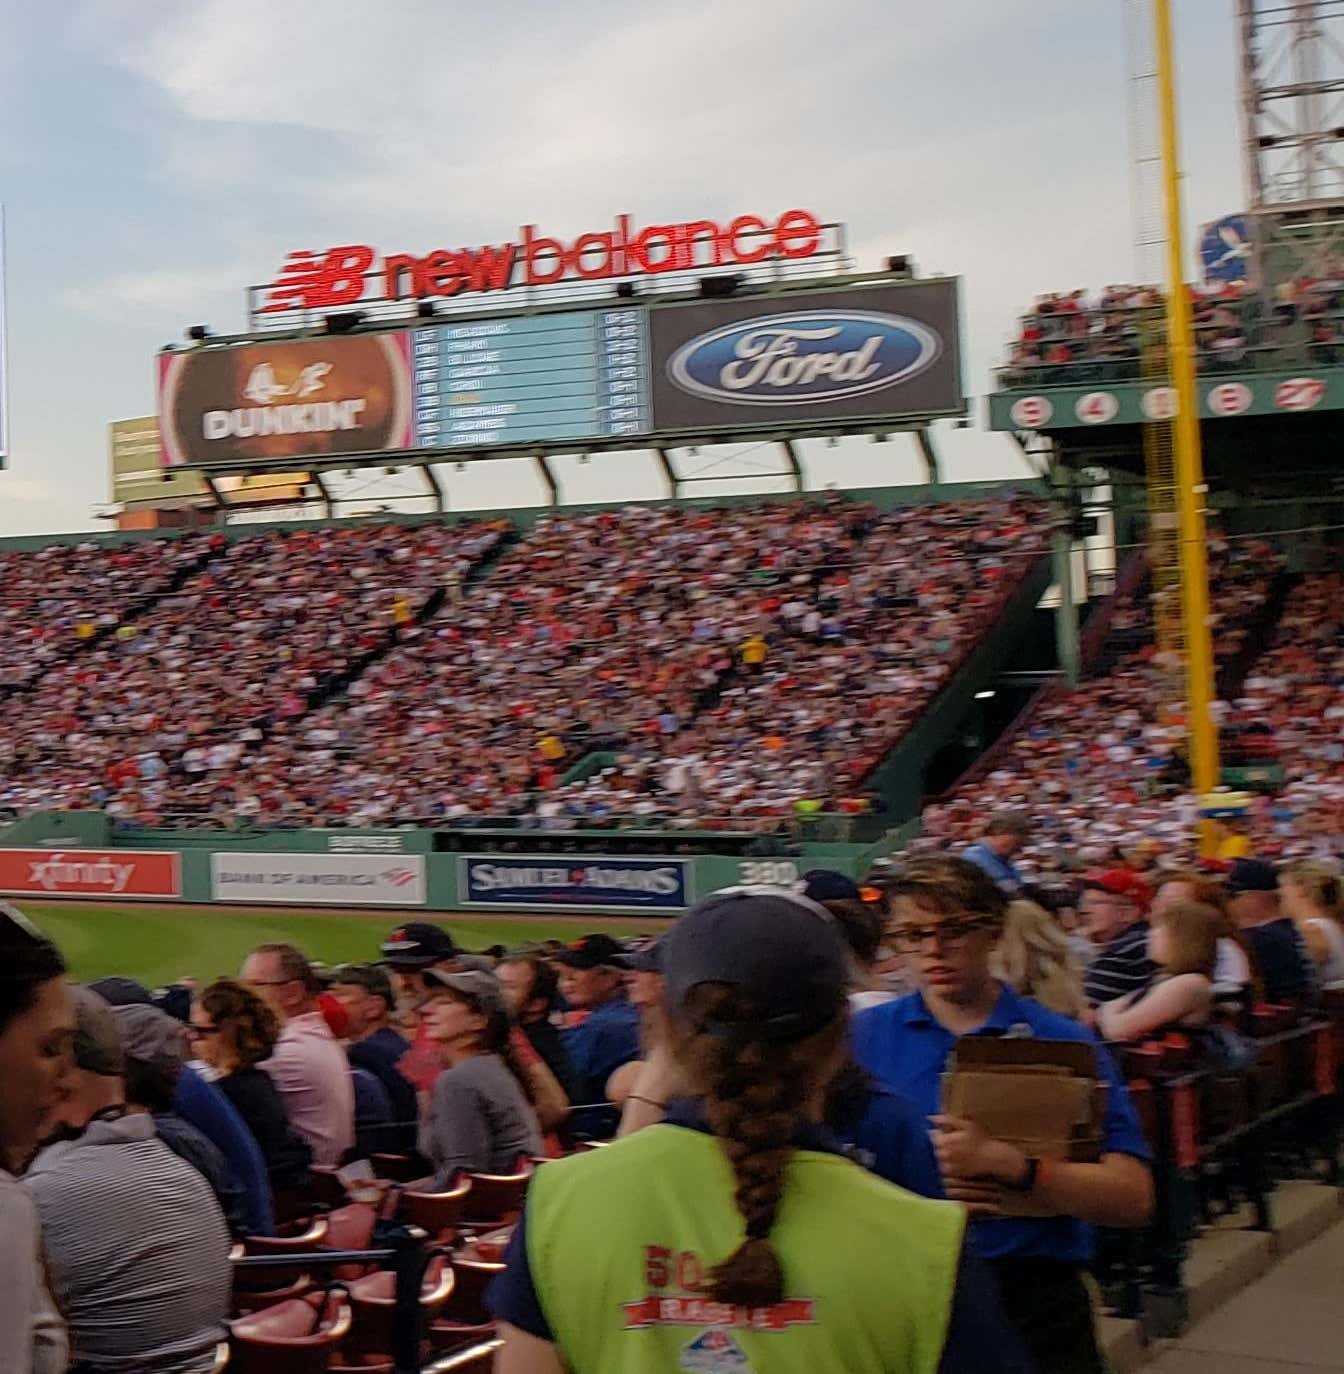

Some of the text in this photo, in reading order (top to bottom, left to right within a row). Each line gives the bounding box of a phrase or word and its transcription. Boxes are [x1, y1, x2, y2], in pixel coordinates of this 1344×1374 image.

[383, 241, 516, 301] new
[520, 207, 824, 285] balance
[719, 326, 885, 390] Ford
[202, 396, 368, 441] DUNKIN'
[27, 857, 135, 892] xfinity
[296, 872, 378, 888] AMERICA
[468, 862, 680, 894] SAMUEL ADAMS
